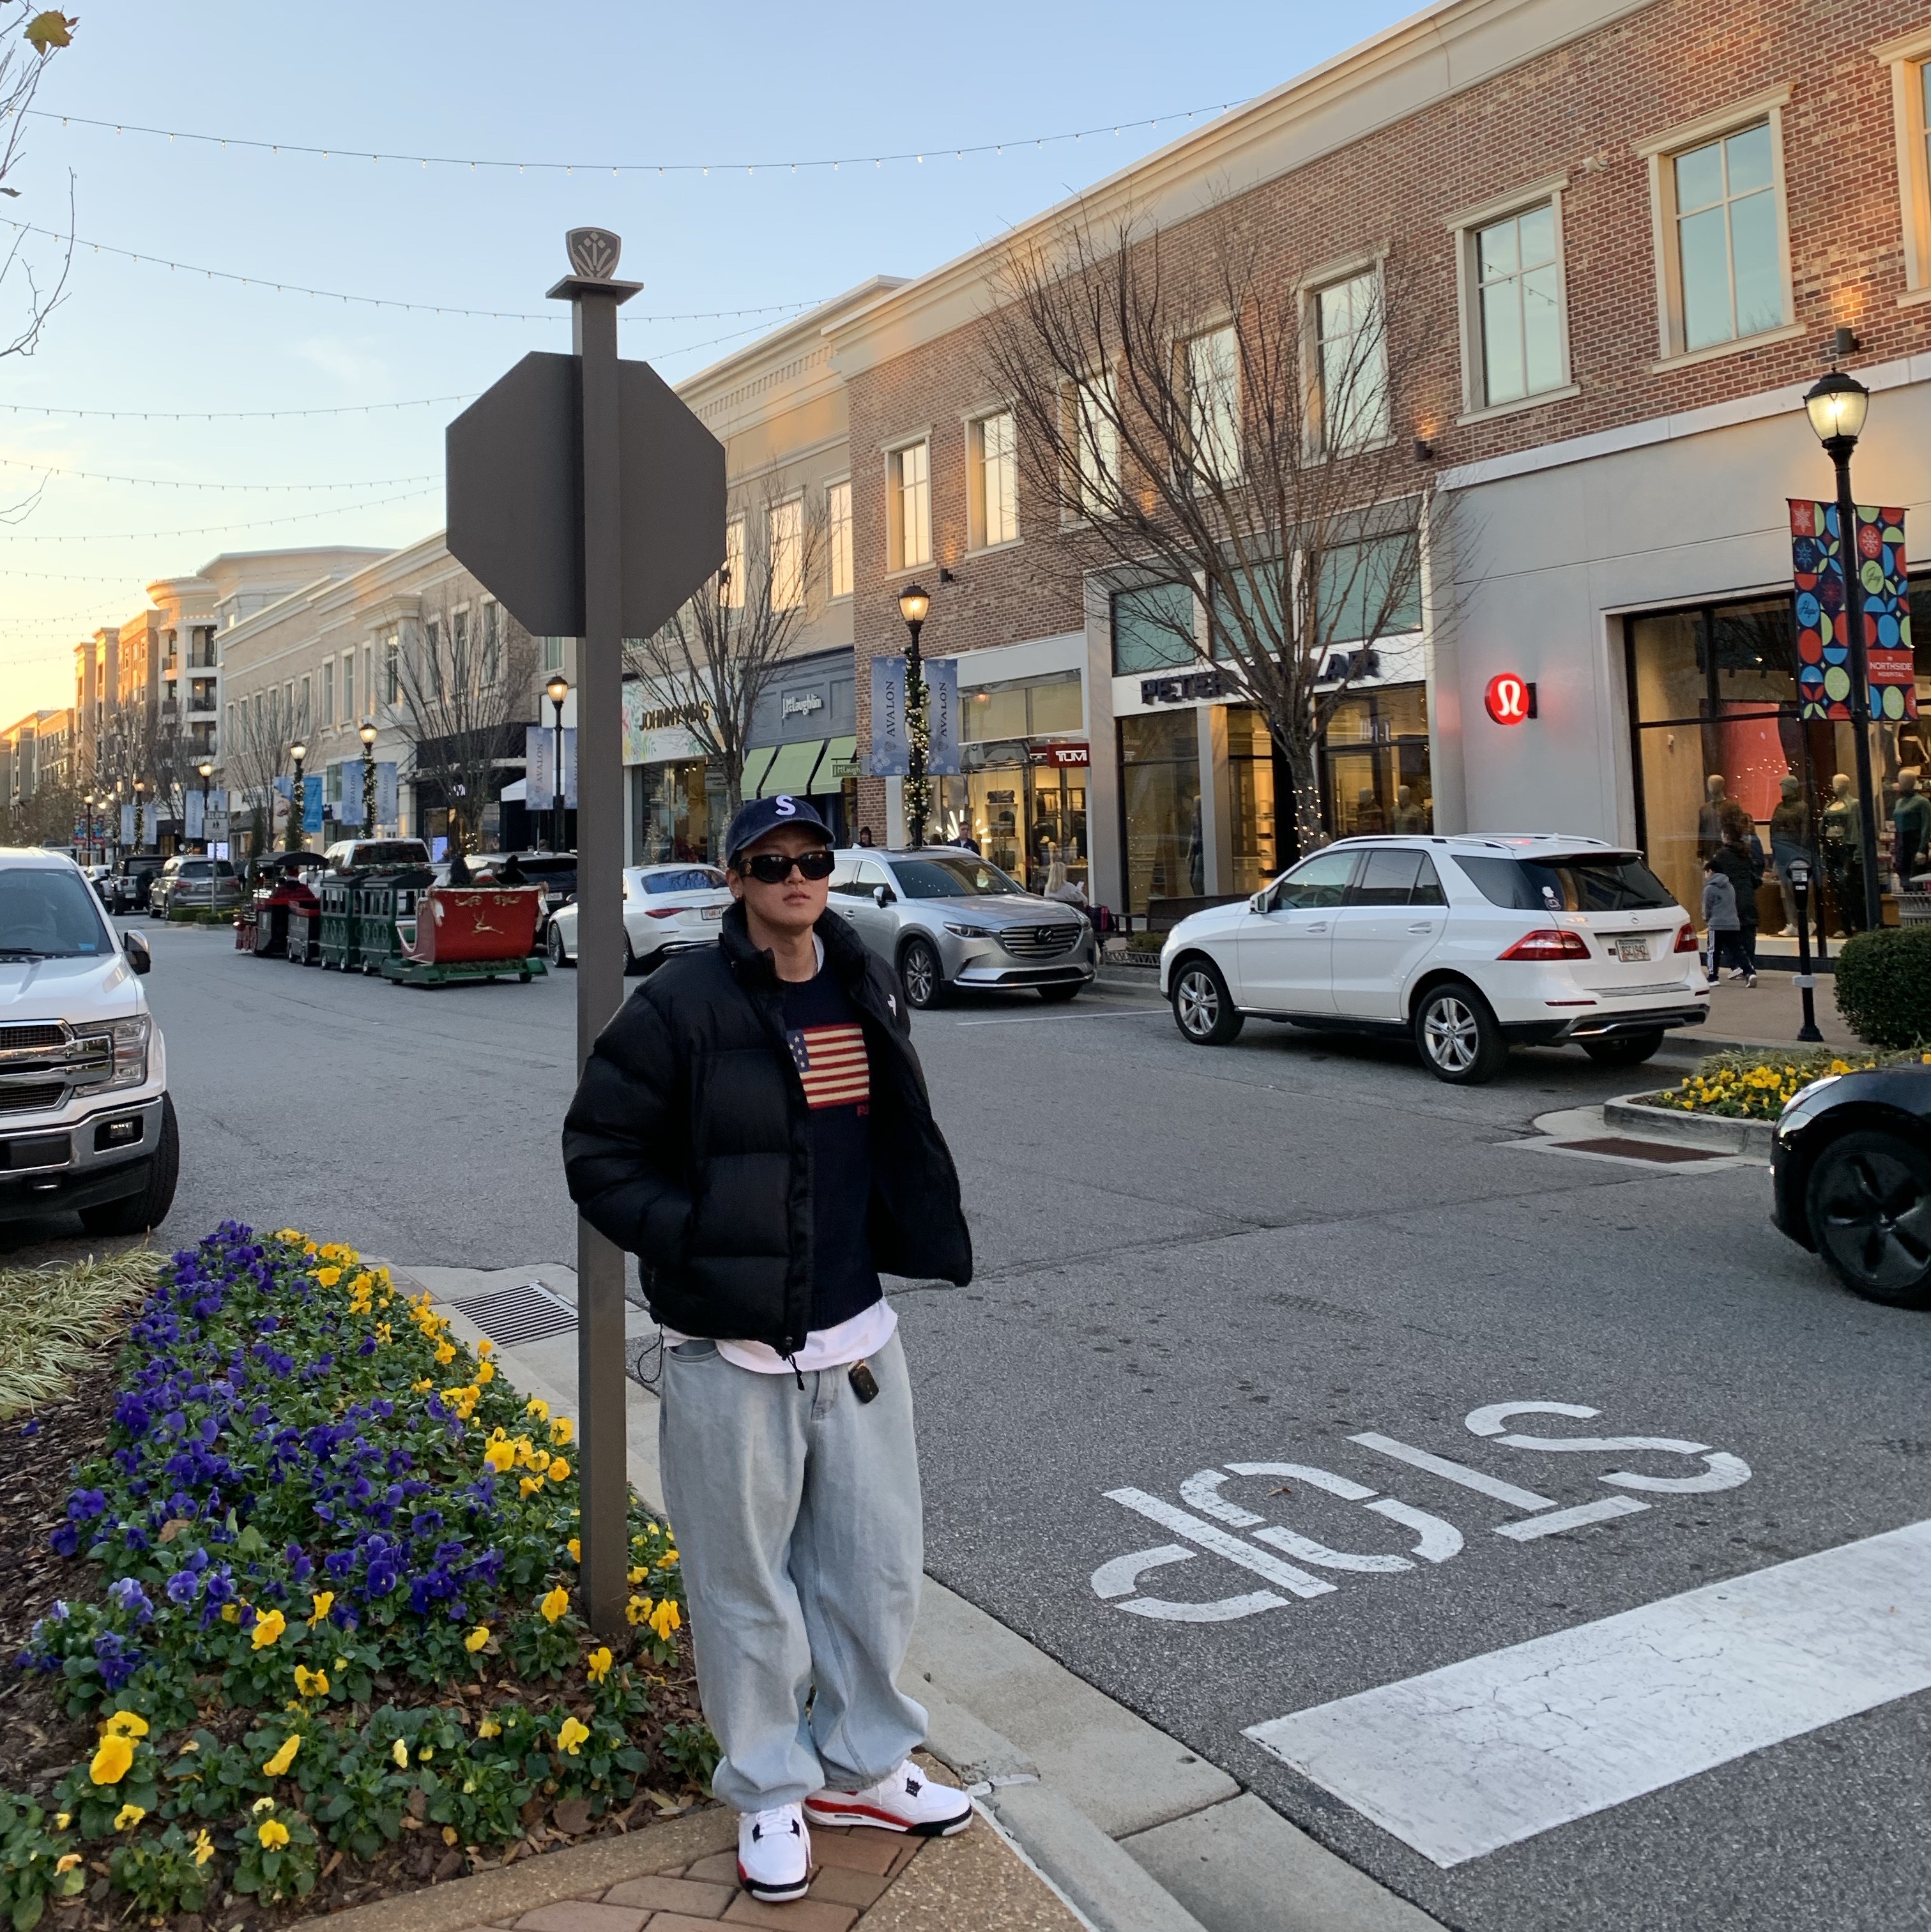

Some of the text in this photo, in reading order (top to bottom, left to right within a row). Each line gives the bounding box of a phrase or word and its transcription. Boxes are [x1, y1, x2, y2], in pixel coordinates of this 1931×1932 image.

[1869, 662, 1913, 671] NORTHSIDE
[885, 681, 896, 737] AVALON
[939, 681, 947, 738] AVALON
[1055, 750, 1088, 762] TUMI
[775, 795, 796, 816] S
[1090, 1401, 1753, 1623] STOP
